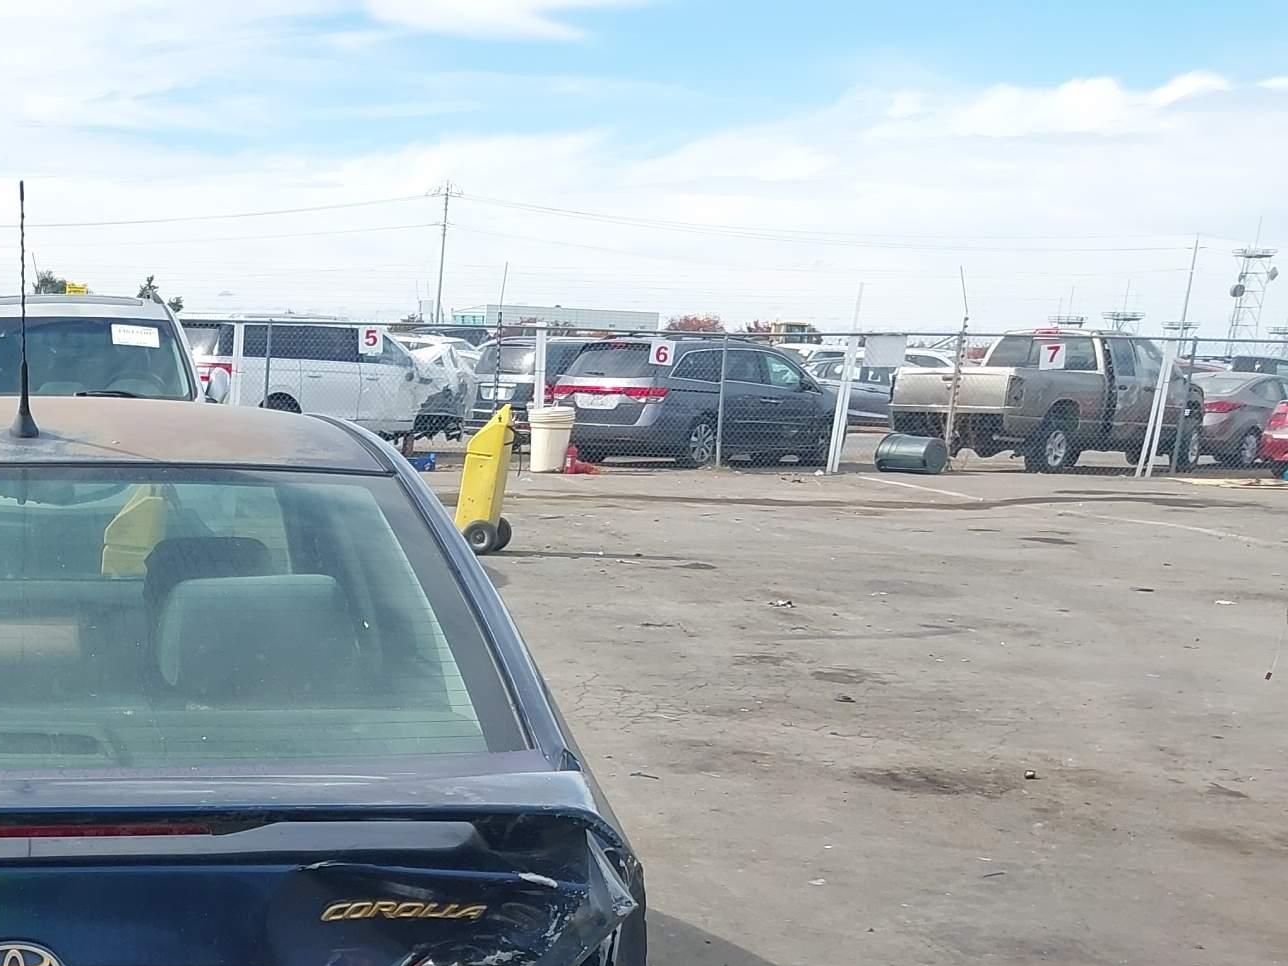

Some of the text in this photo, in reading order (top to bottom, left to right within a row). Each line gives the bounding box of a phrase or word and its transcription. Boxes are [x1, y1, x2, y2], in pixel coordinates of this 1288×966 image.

[365, 329, 378, 347] 5
[655, 346, 668, 363] 6
[1047, 345, 1061, 363] 7
[320, 901, 488, 922] COROLLA
